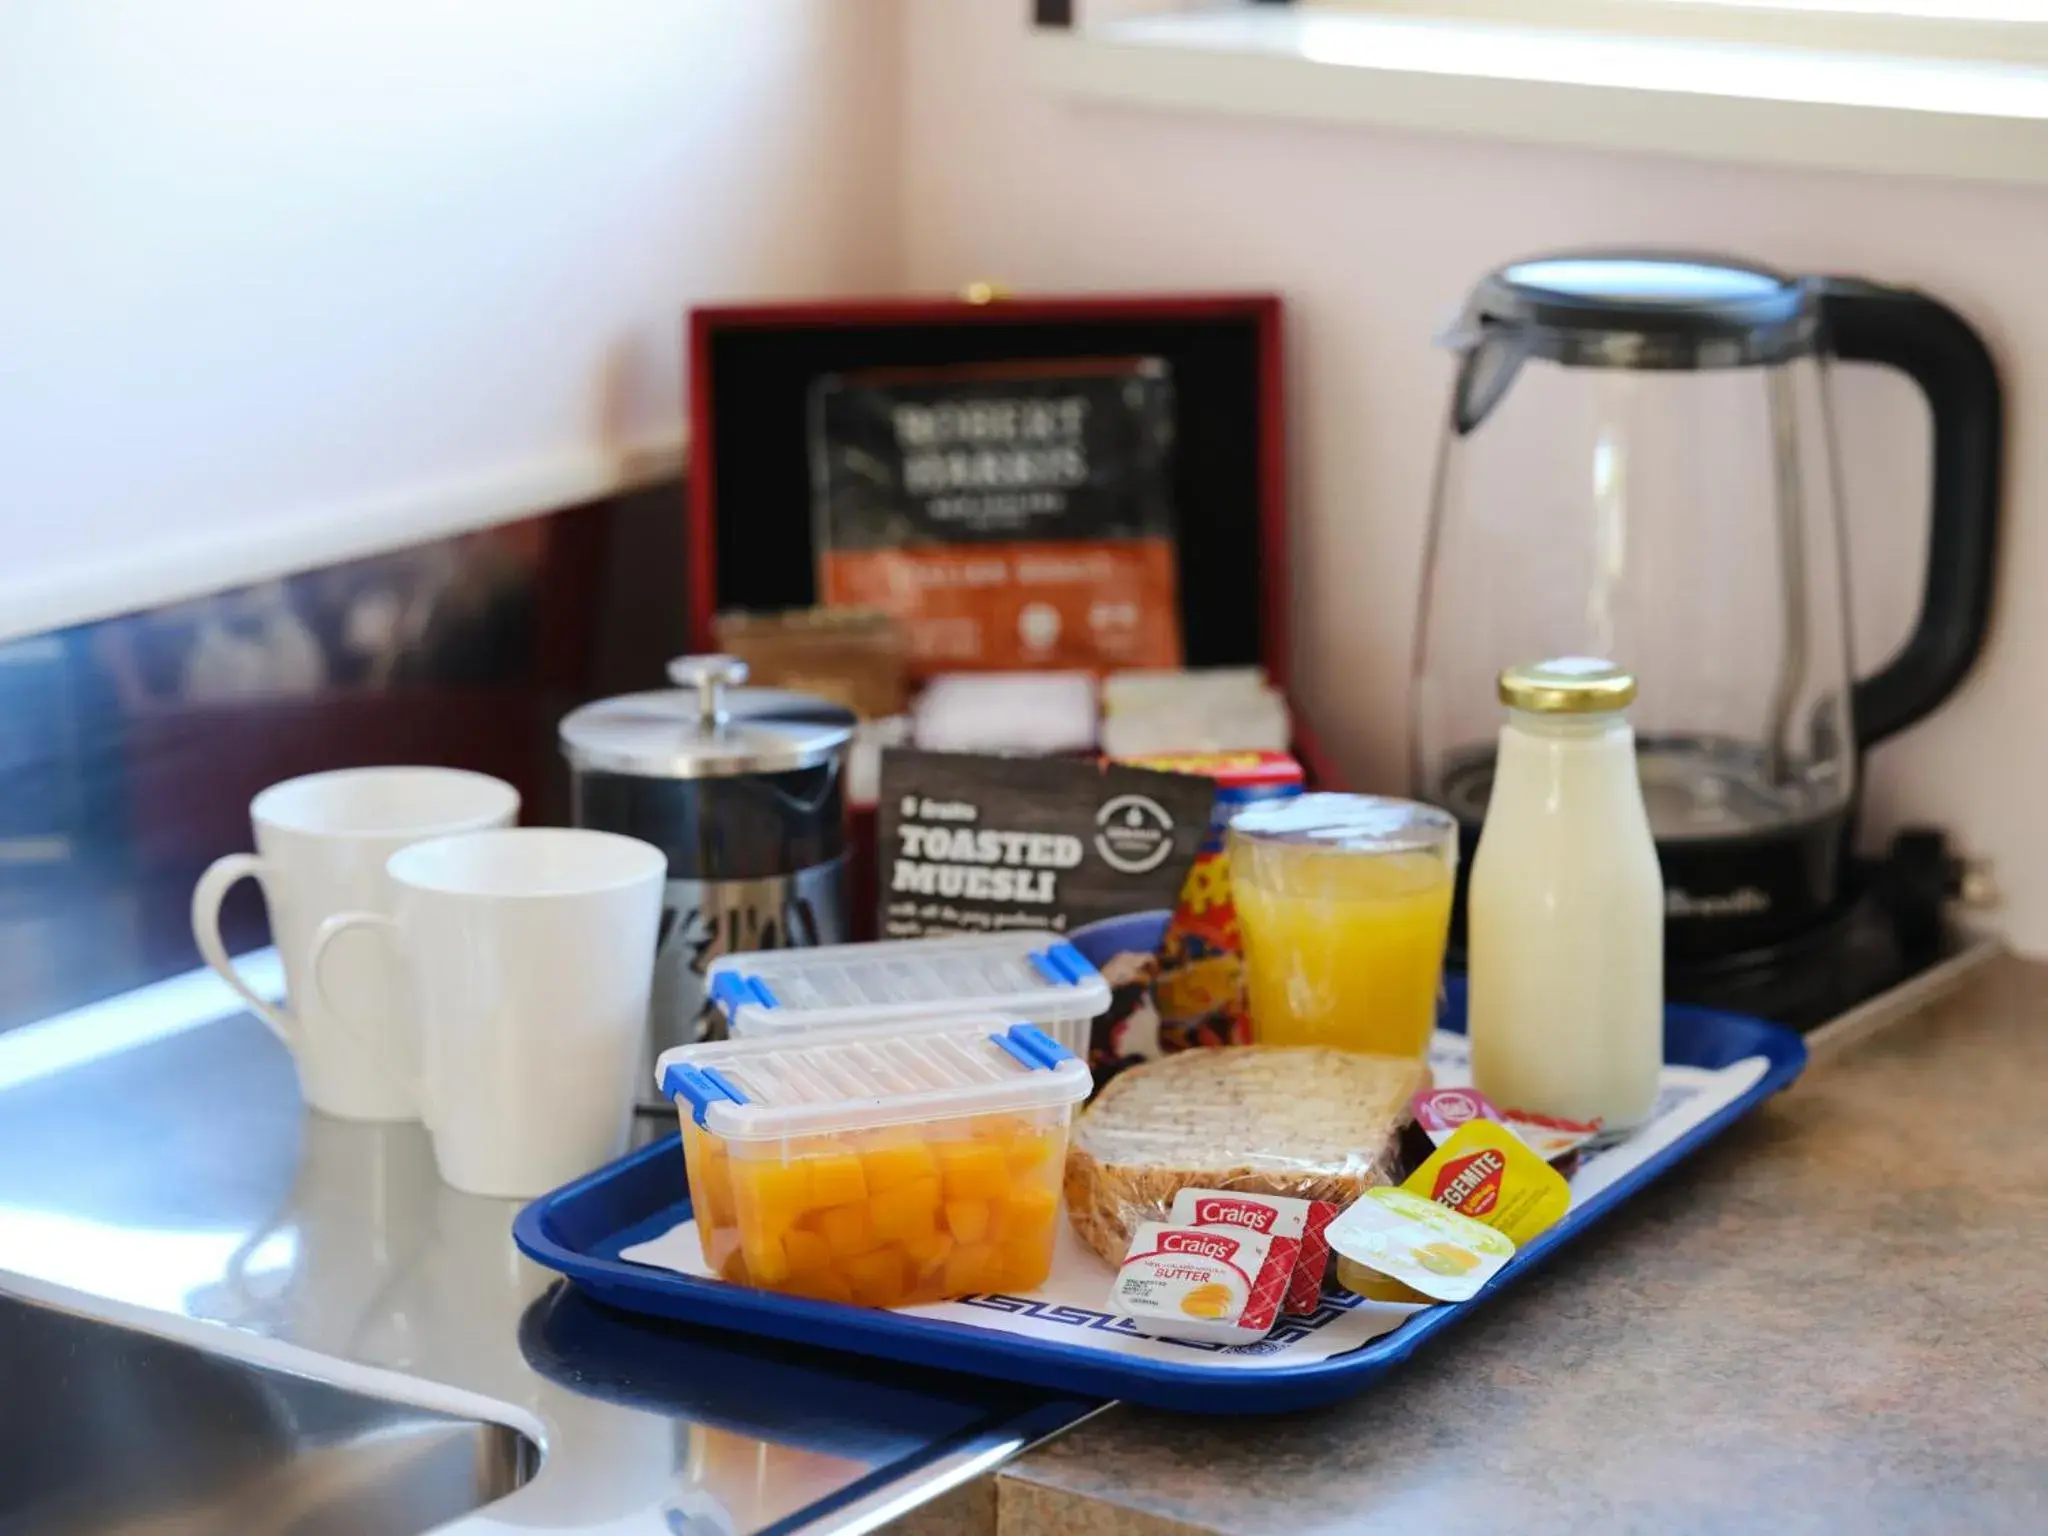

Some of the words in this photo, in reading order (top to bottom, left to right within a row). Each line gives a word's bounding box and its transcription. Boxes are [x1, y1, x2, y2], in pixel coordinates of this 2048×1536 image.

[898, 825, 1084, 869] TOASTED
[892, 859, 1056, 904] MUESLI
[1436, 1151, 1503, 1212] EGEMITE
[1202, 1203, 1267, 1231] Craig's
[1163, 1235, 1229, 1259] Craig's
[1154, 1268, 1212, 1283] BUTTER
